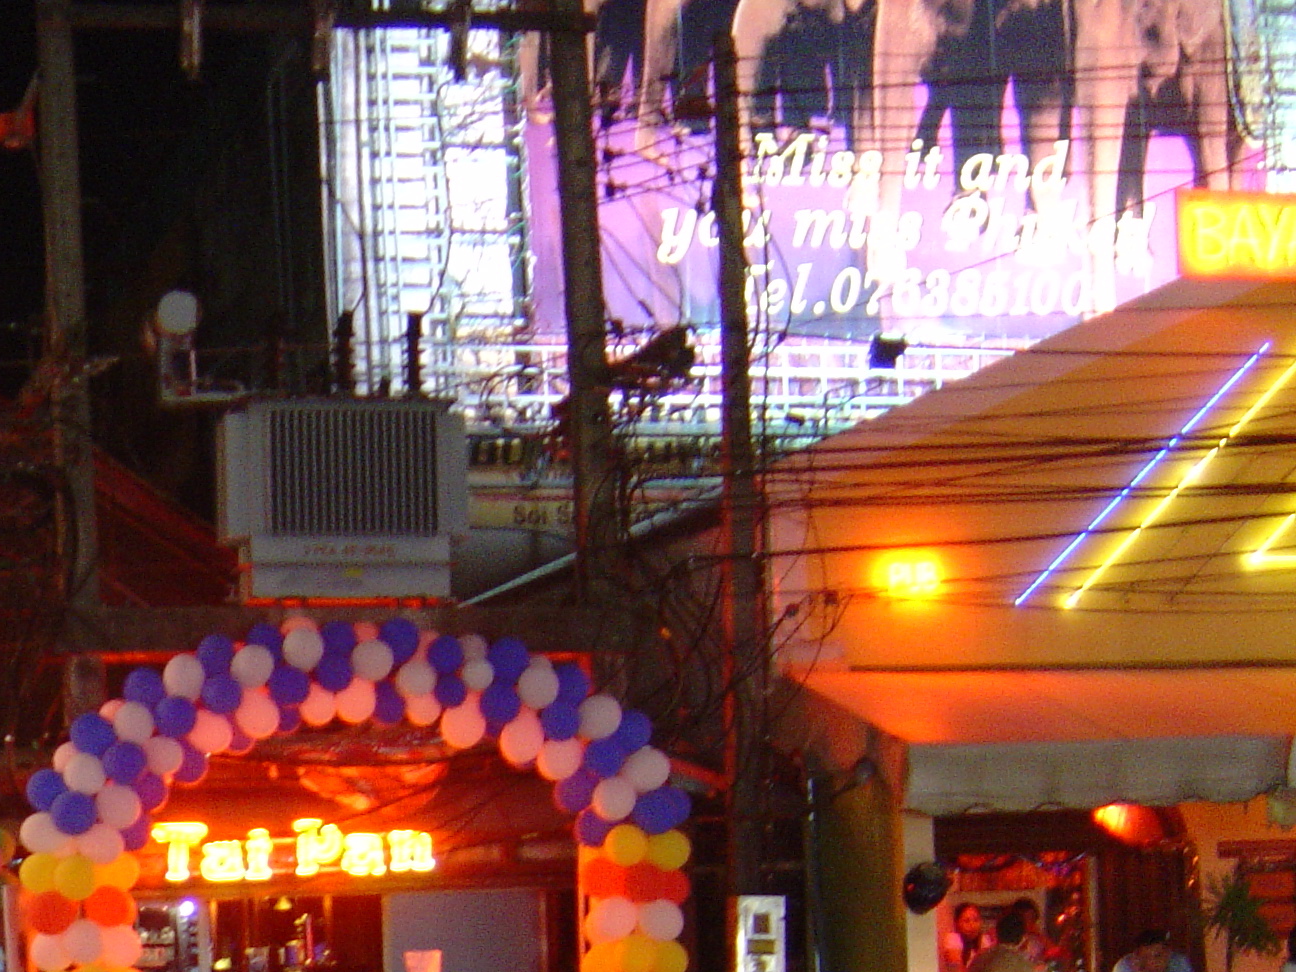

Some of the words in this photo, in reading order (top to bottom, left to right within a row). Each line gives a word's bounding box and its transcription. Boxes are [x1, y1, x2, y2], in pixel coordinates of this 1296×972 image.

[903, 138, 943, 189] it
[959, 139, 1071, 193] and
[792, 207, 924, 250] miss
[151, 820, 274, 882] Tai
[292, 817, 436, 876] Pan
